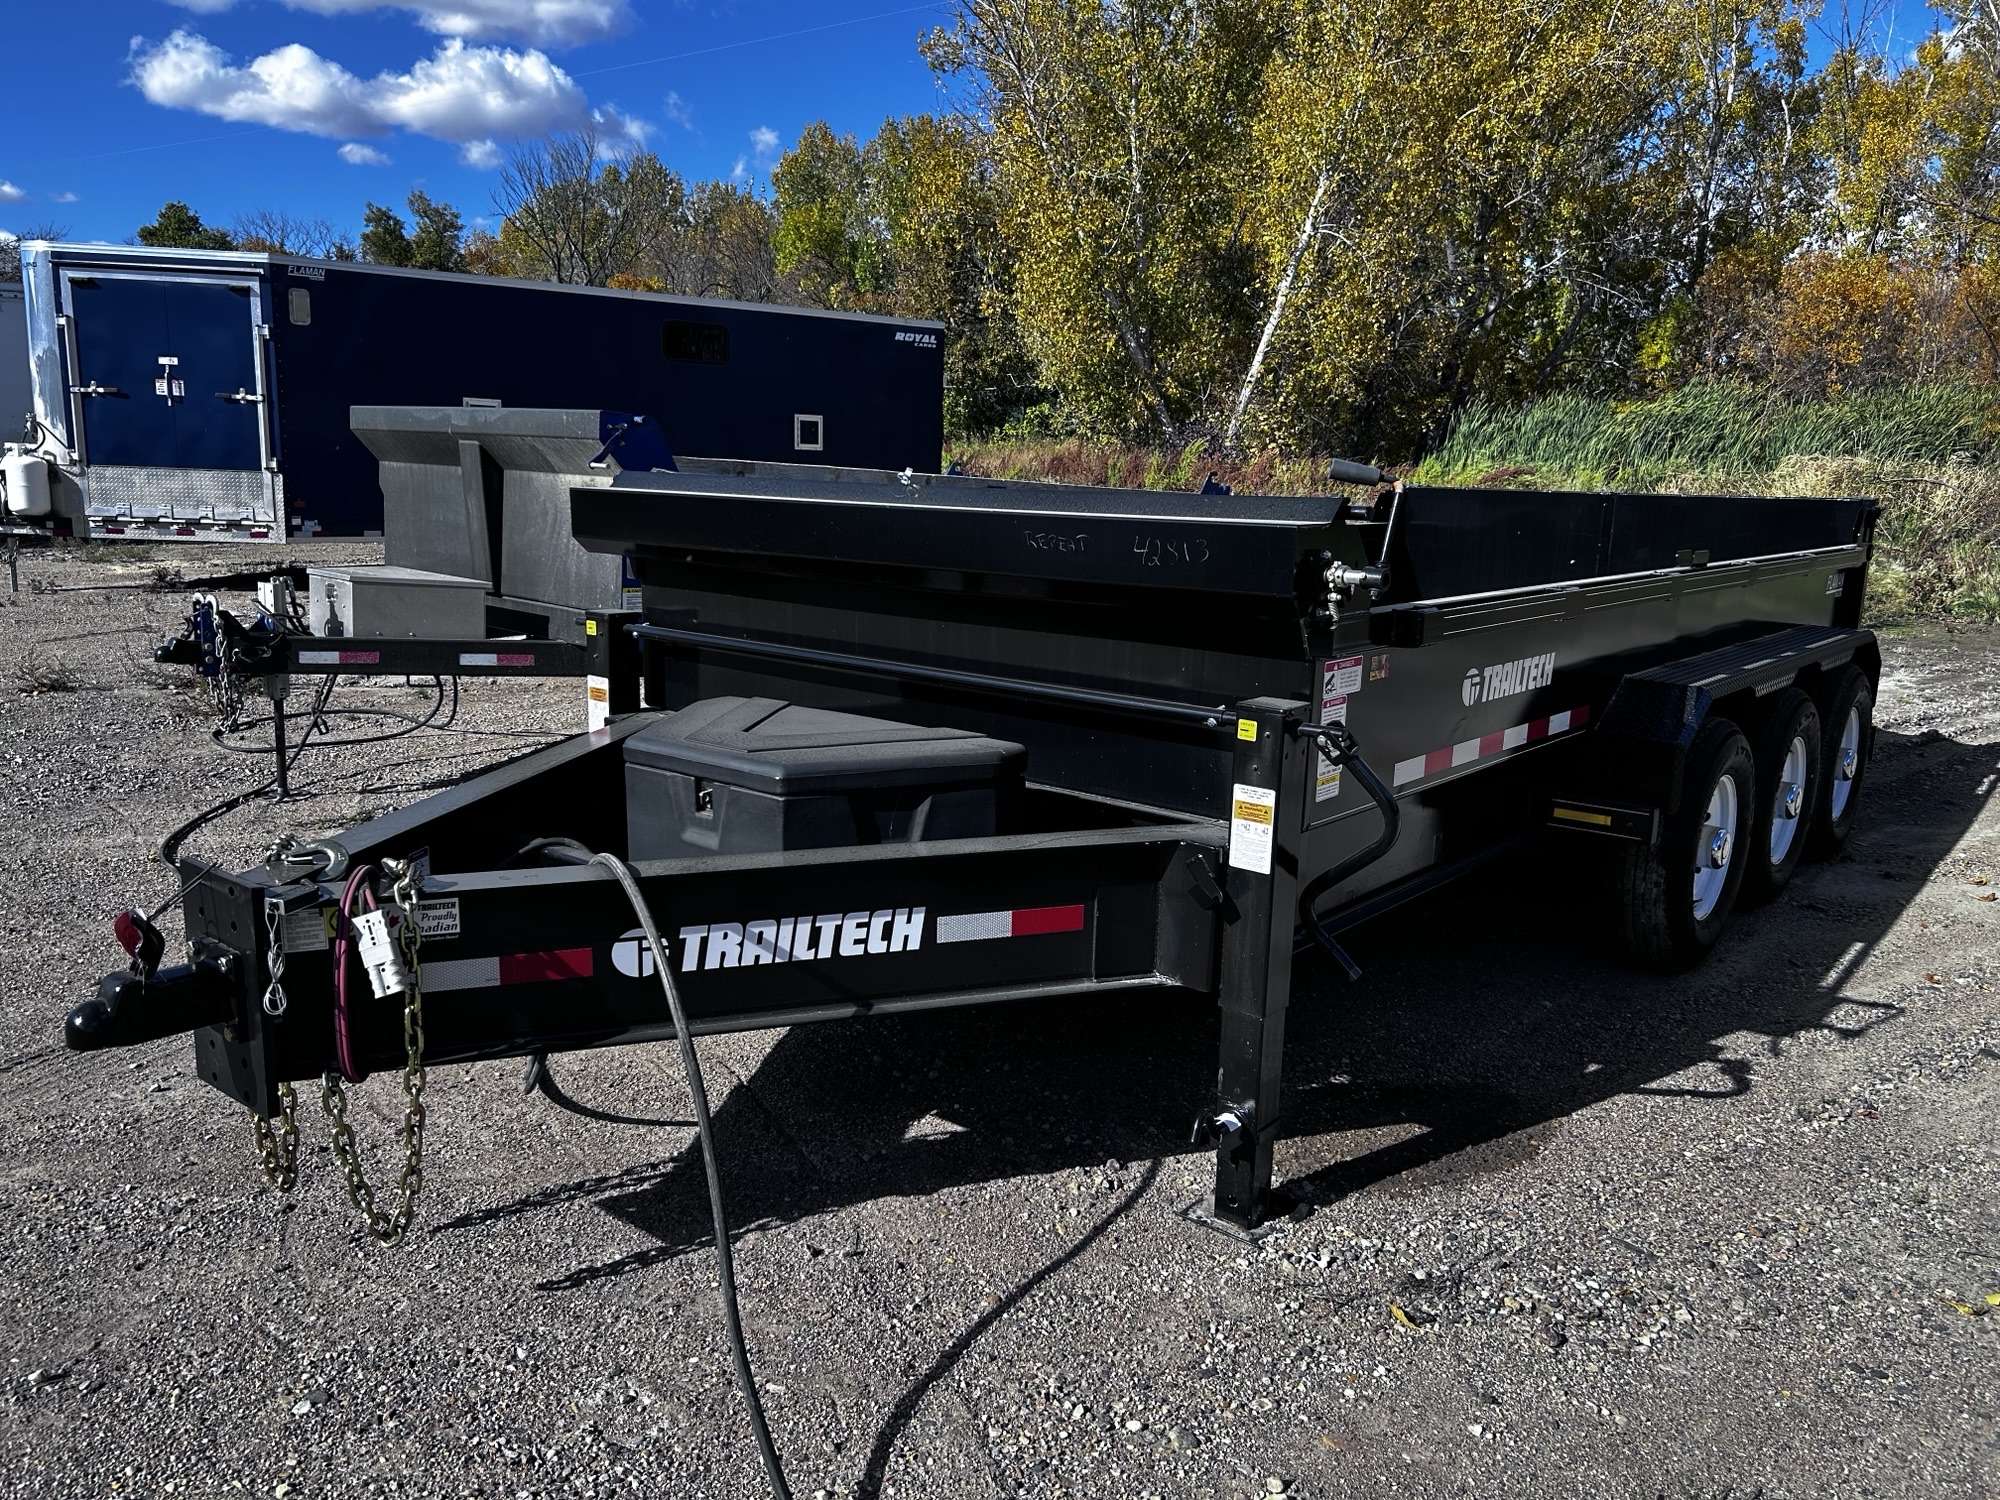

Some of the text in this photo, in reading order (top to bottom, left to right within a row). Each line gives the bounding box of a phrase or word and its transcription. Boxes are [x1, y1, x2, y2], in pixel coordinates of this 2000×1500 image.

[288, 265, 326, 278] FLAMAN
[895, 331, 937, 343] ROYAL
[1481, 652, 1556, 702] TRAILTECH
[421, 911, 457, 922] Proudly
[405, 922, 458, 935] nadian
[679, 906, 926, 972] TRAILTECH
